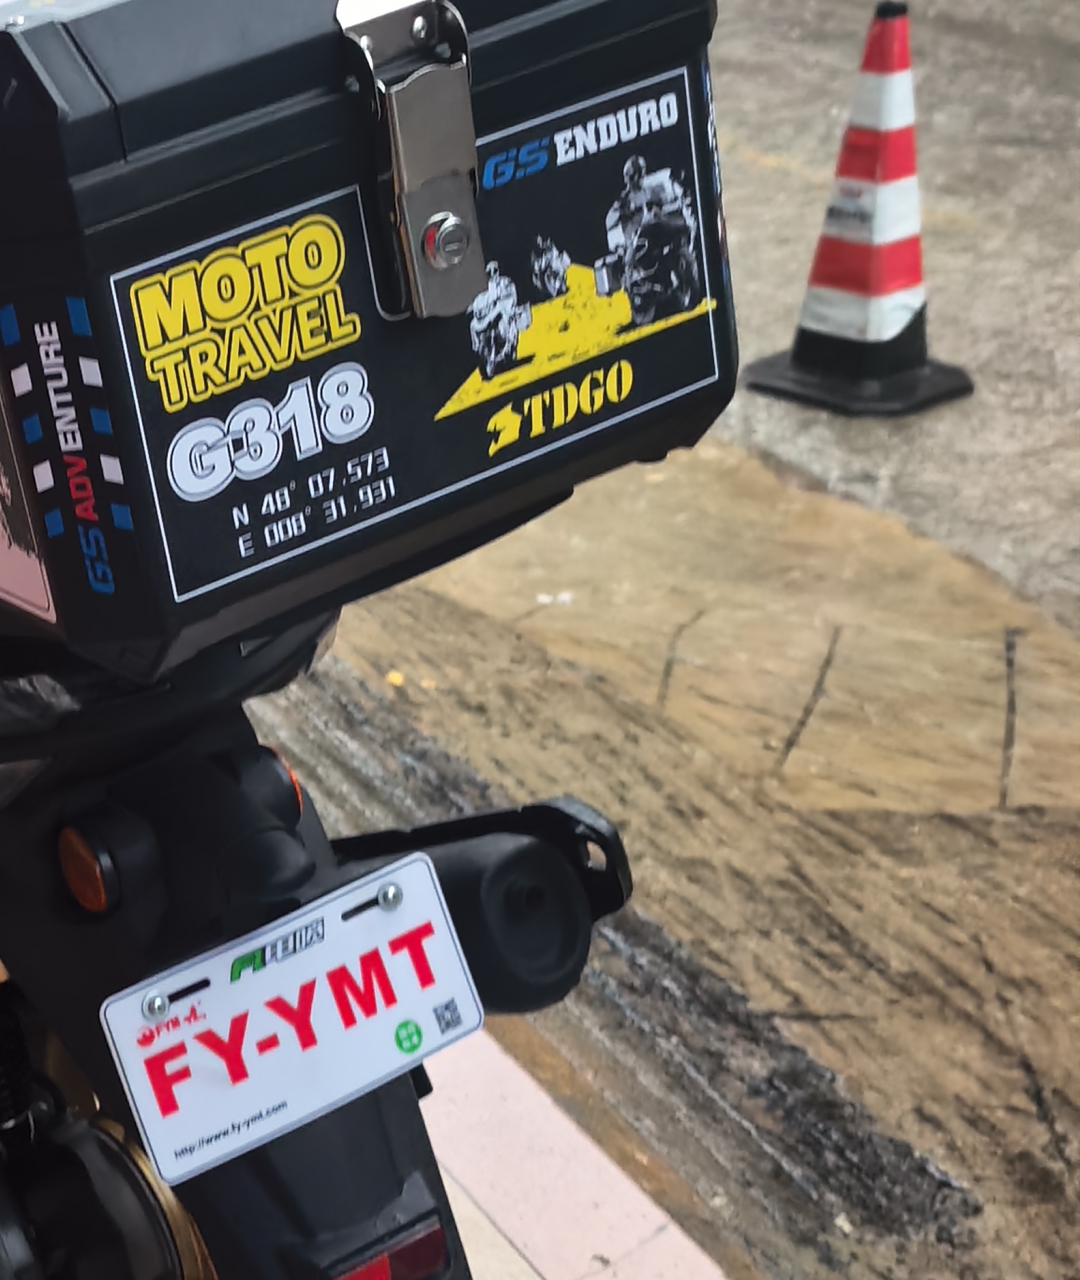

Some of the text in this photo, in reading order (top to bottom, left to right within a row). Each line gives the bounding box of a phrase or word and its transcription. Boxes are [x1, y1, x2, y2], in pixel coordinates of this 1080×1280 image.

[482, 92, 679, 190] GS ENDURO
[130, 213, 345, 358] MOTO
[146, 283, 361, 412] TRAVEL
[167, 362, 374, 502] G318
[524, 360, 633, 439] TDGO
[77, 523, 115, 595] GS
[232, 502, 250, 530] N
[238, 532, 254, 558] E
[143, 920, 435, 1120] FY-YMT
